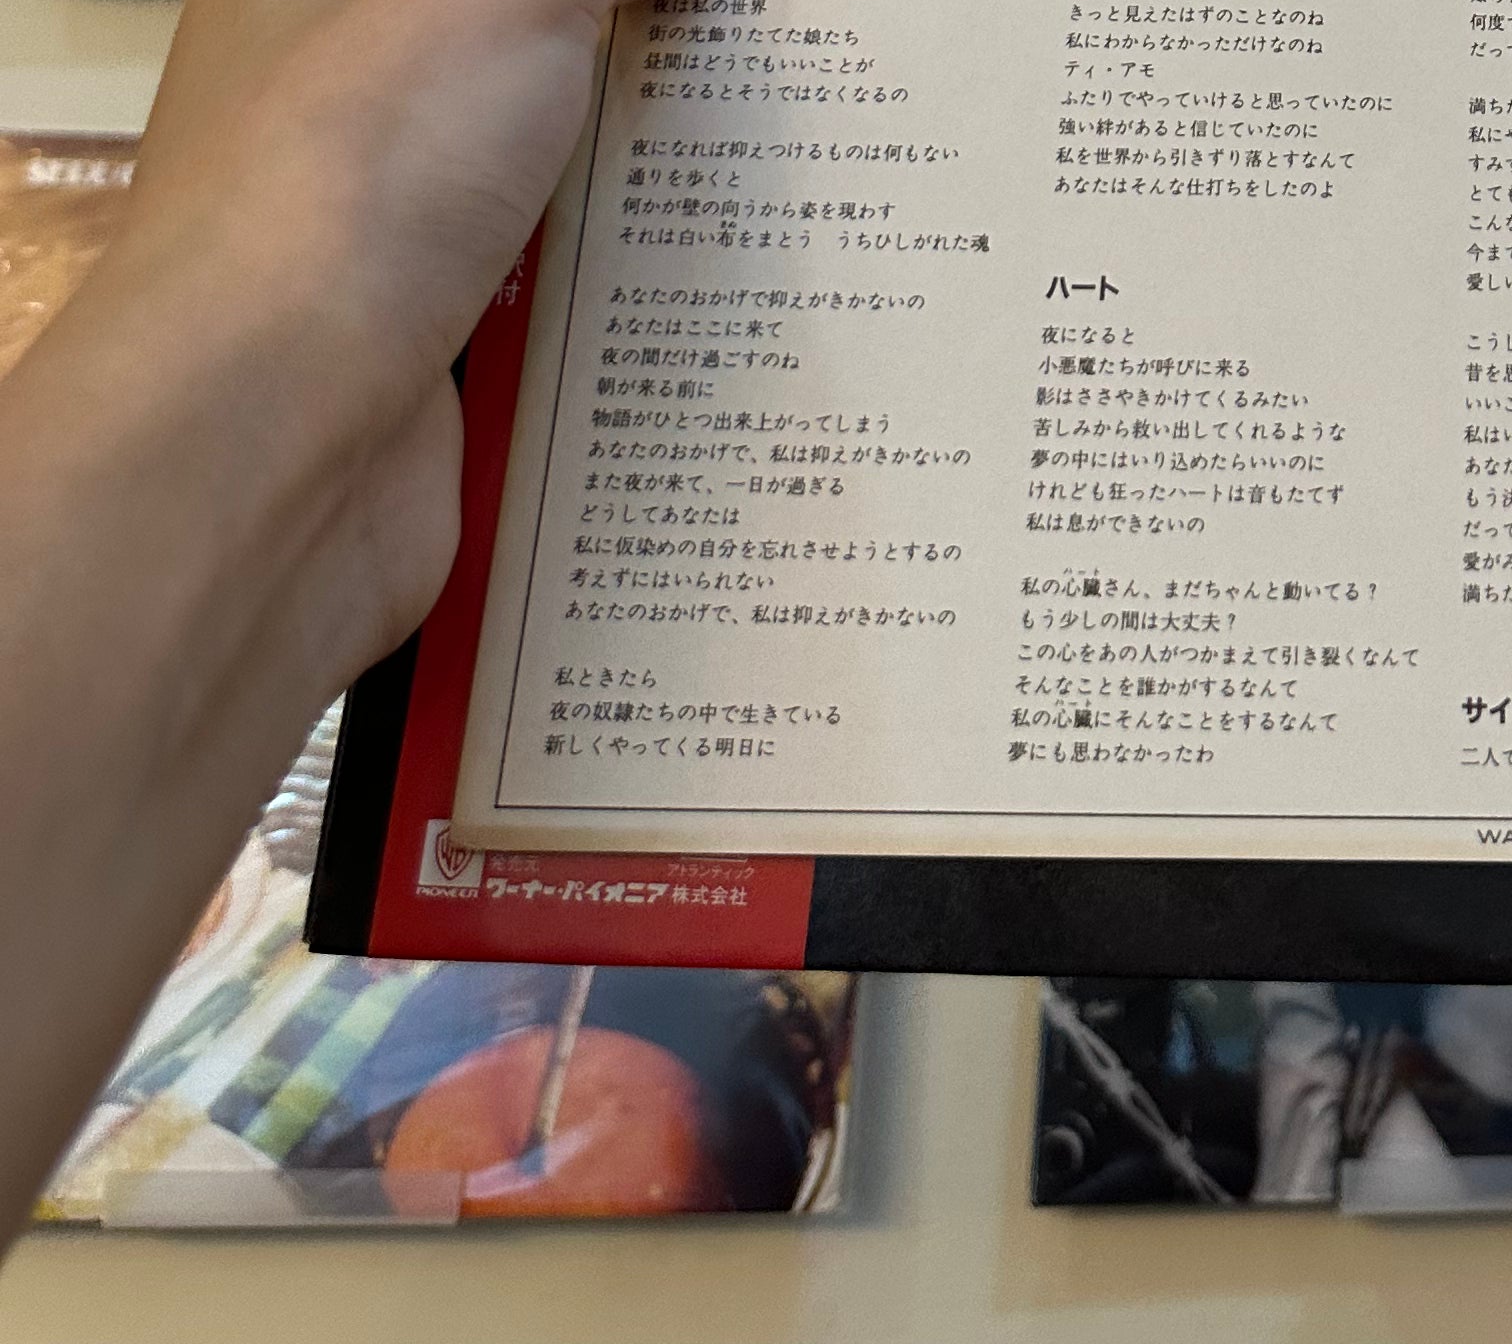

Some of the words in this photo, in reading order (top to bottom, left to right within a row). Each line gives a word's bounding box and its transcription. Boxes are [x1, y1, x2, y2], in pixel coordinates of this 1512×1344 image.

[626, 166, 740, 188] 通りを歩くと
[1043, 274, 1120, 301] ハート
[604, 316, 783, 339] あなたはここに来て
[1039, 324, 1135, 346] 夜になると
[596, 375, 714, 399] 朝が来る前に
[579, 501, 740, 526] どうしてあなたは
[1024, 510, 1205, 535] 私は息ができないの
[553, 665, 656, 689] 私ときたら
